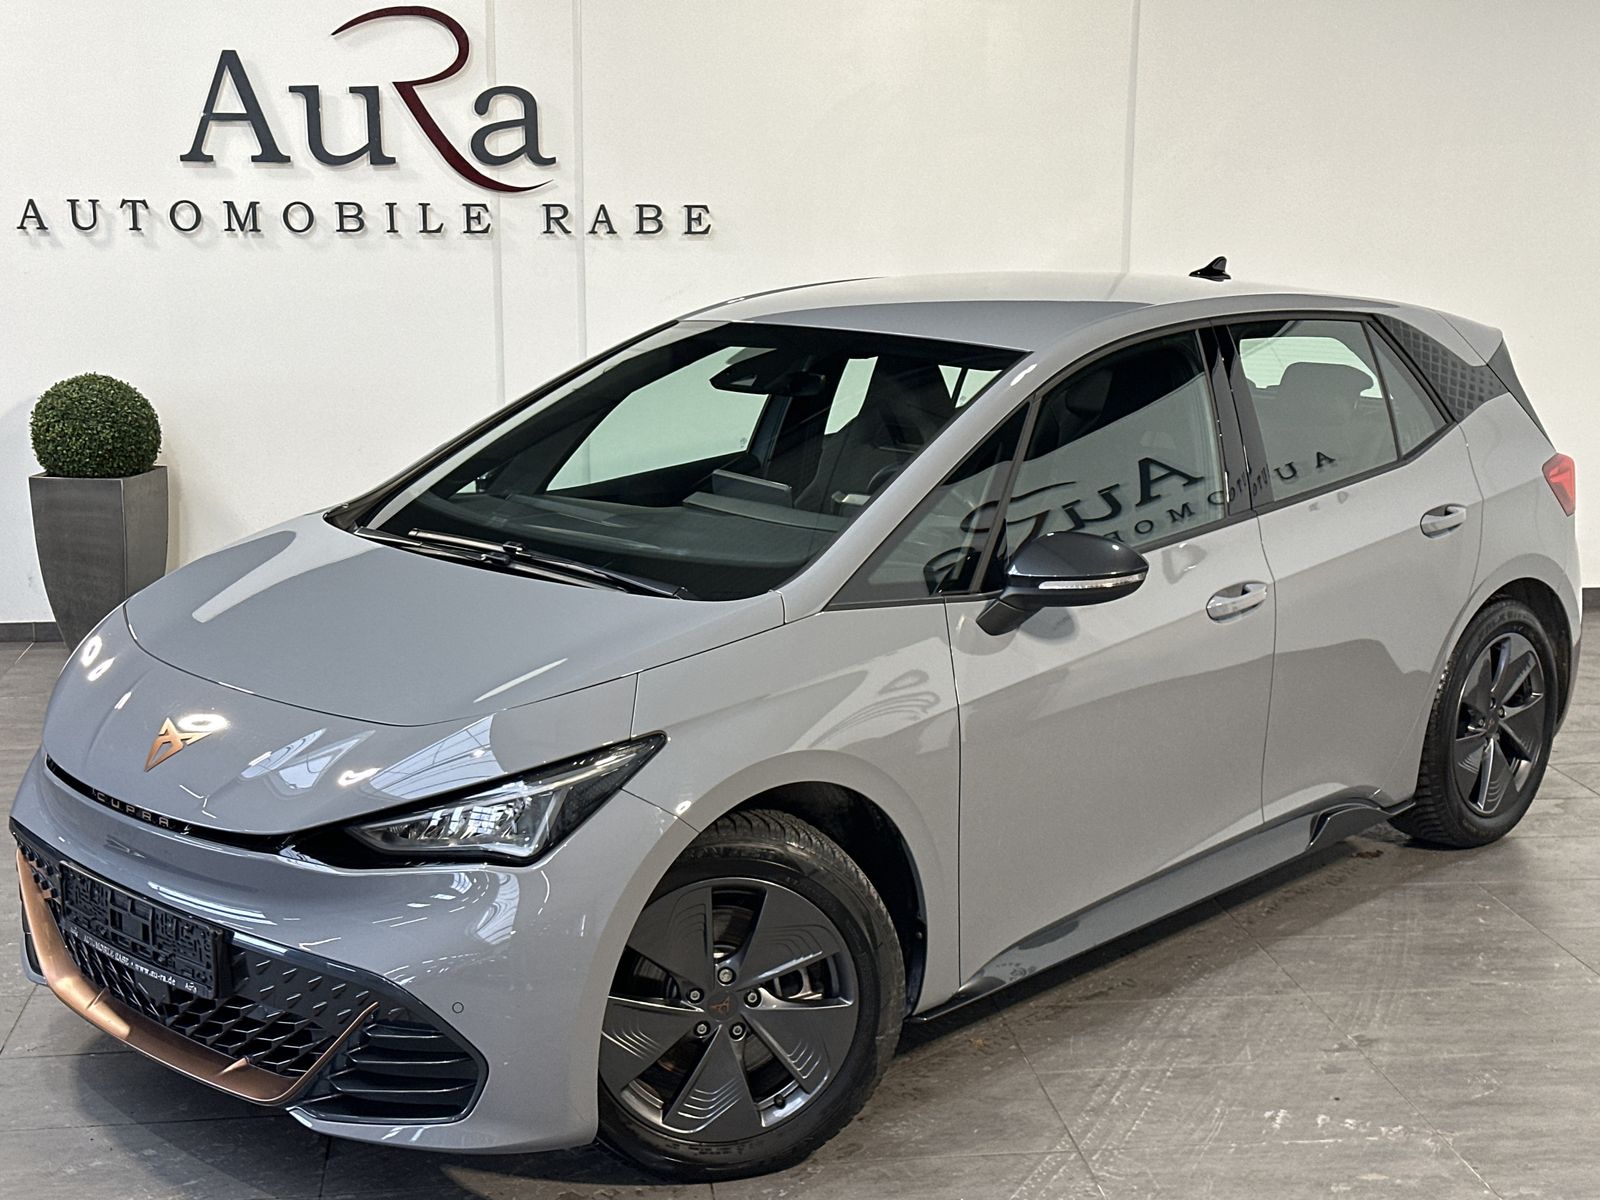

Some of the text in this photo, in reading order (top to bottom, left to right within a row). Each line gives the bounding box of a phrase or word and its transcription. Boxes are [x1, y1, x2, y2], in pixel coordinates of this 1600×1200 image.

[17, 198, 711, 235] AUTOMOBILE RABE
[96, 791, 169, 828] CUPRA
